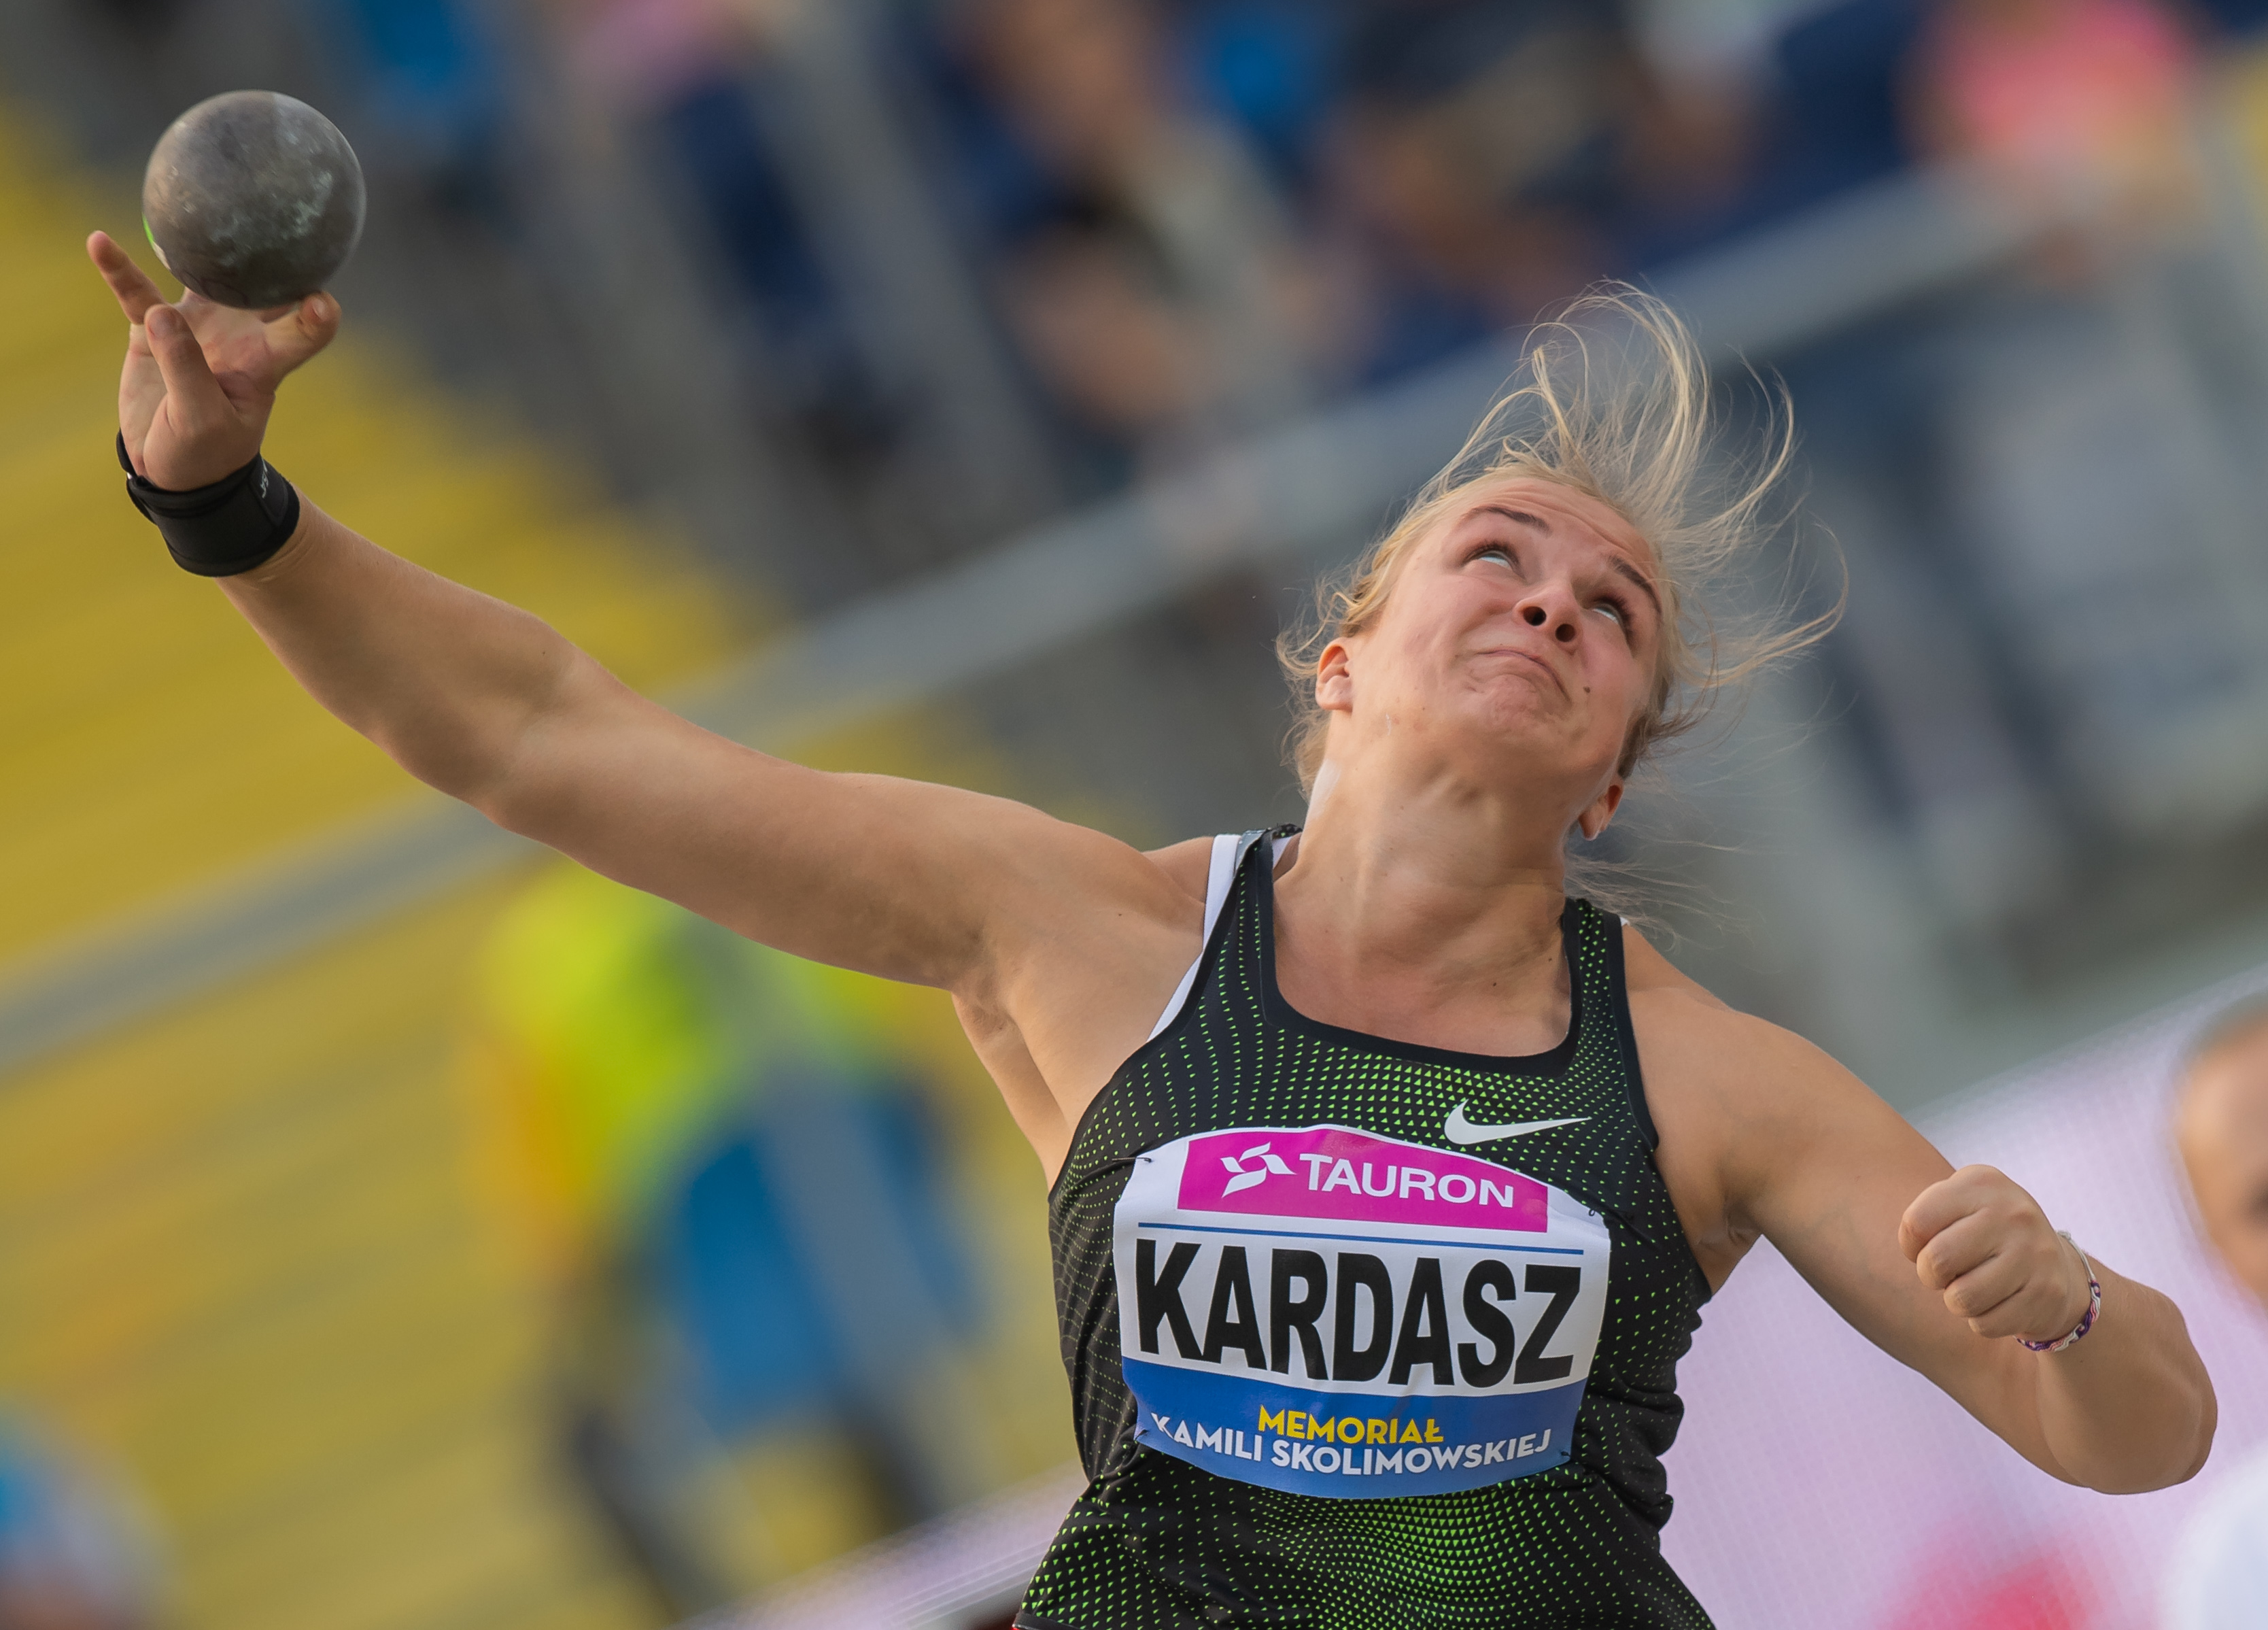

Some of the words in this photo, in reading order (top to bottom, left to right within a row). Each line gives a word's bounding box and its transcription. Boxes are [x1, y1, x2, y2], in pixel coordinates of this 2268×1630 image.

[1299, 1153, 1514, 1208] TAURON
[1135, 1238, 1581, 1388] KARDASZ
[1151, 1412, 1262, 1461] KAMILI
[1271, 1429, 1551, 1475] SKOLIMOWSKIEJ
[1258, 1404, 1444, 1444] MEMORIAŁ
